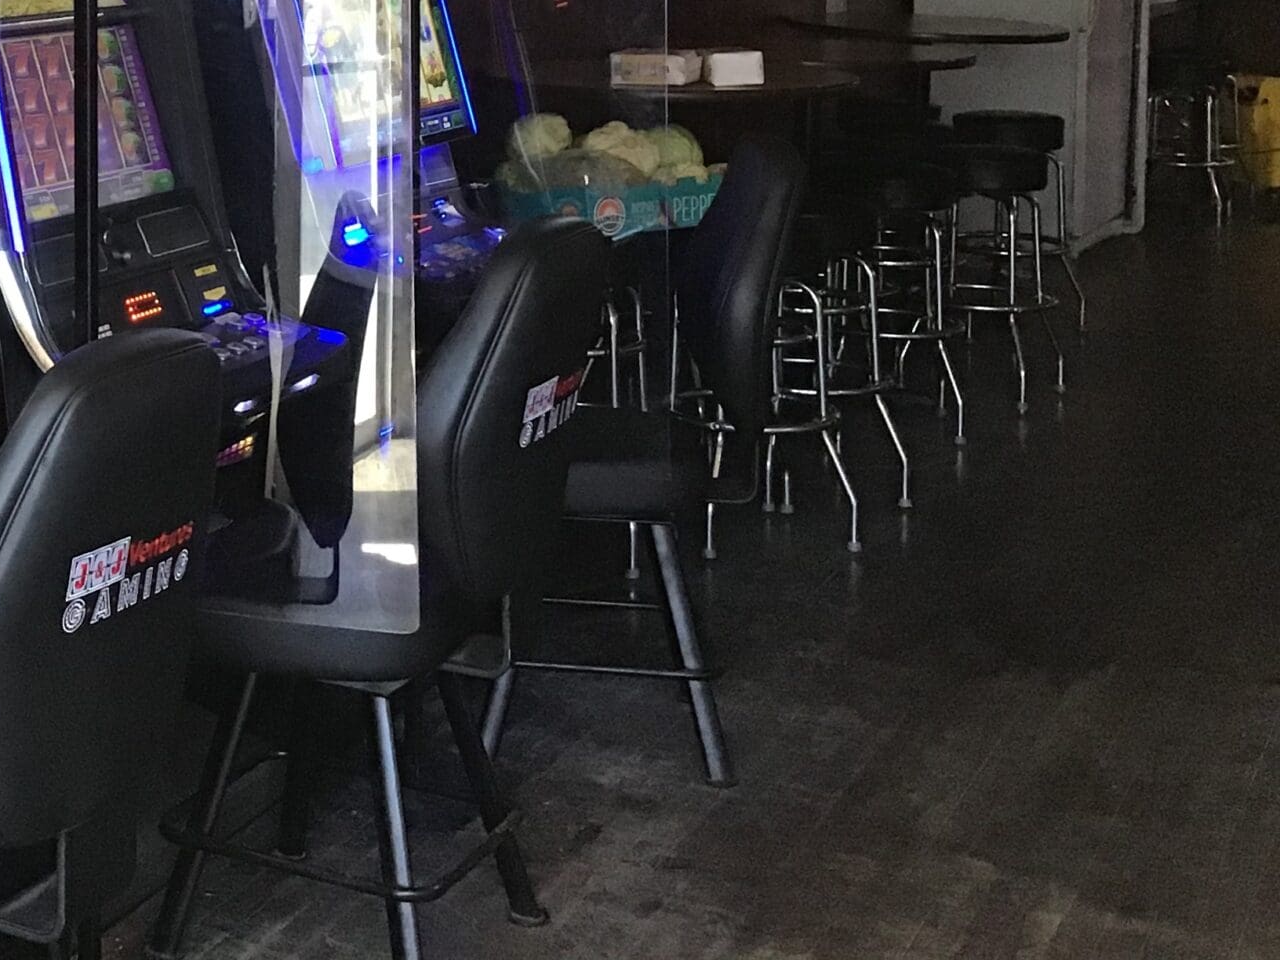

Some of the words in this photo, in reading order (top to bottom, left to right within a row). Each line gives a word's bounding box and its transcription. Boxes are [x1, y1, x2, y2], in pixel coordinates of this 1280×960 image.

[519, 390, 579, 448] GAMIN
[62, 548, 188, 633] GAMING
[71, 543, 127, 594] J&J
